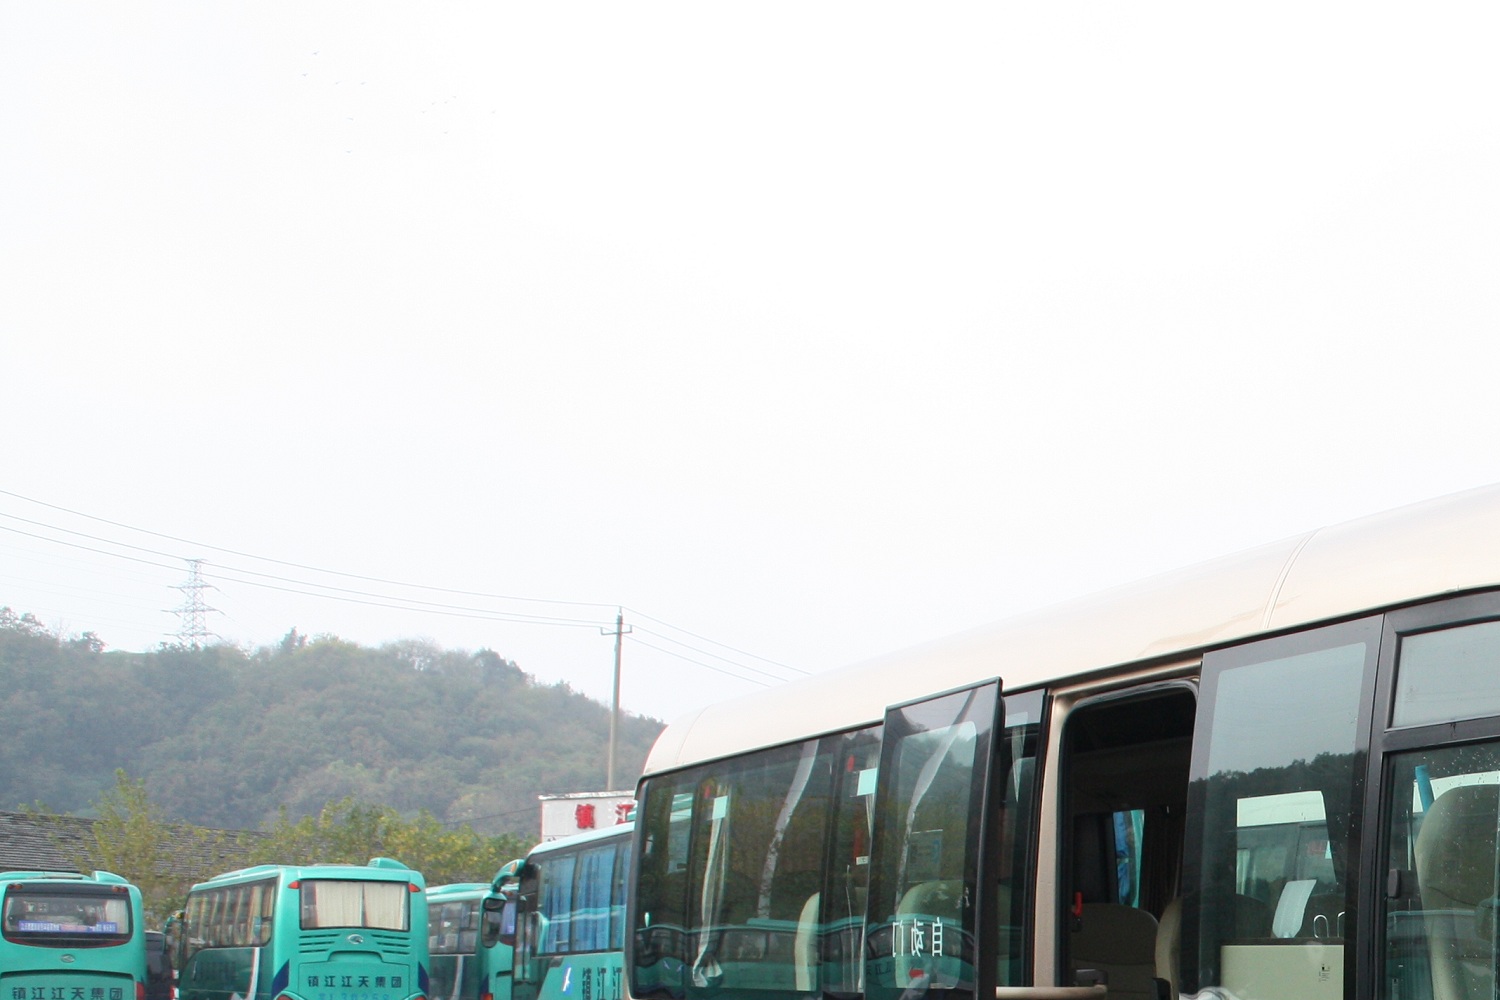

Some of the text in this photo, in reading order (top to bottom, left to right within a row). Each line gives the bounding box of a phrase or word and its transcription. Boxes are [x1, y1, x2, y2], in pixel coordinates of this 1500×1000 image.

[308, 975, 402, 989] 镇江江天集团
[12, 986, 123, 1000] 镇江江天集团
